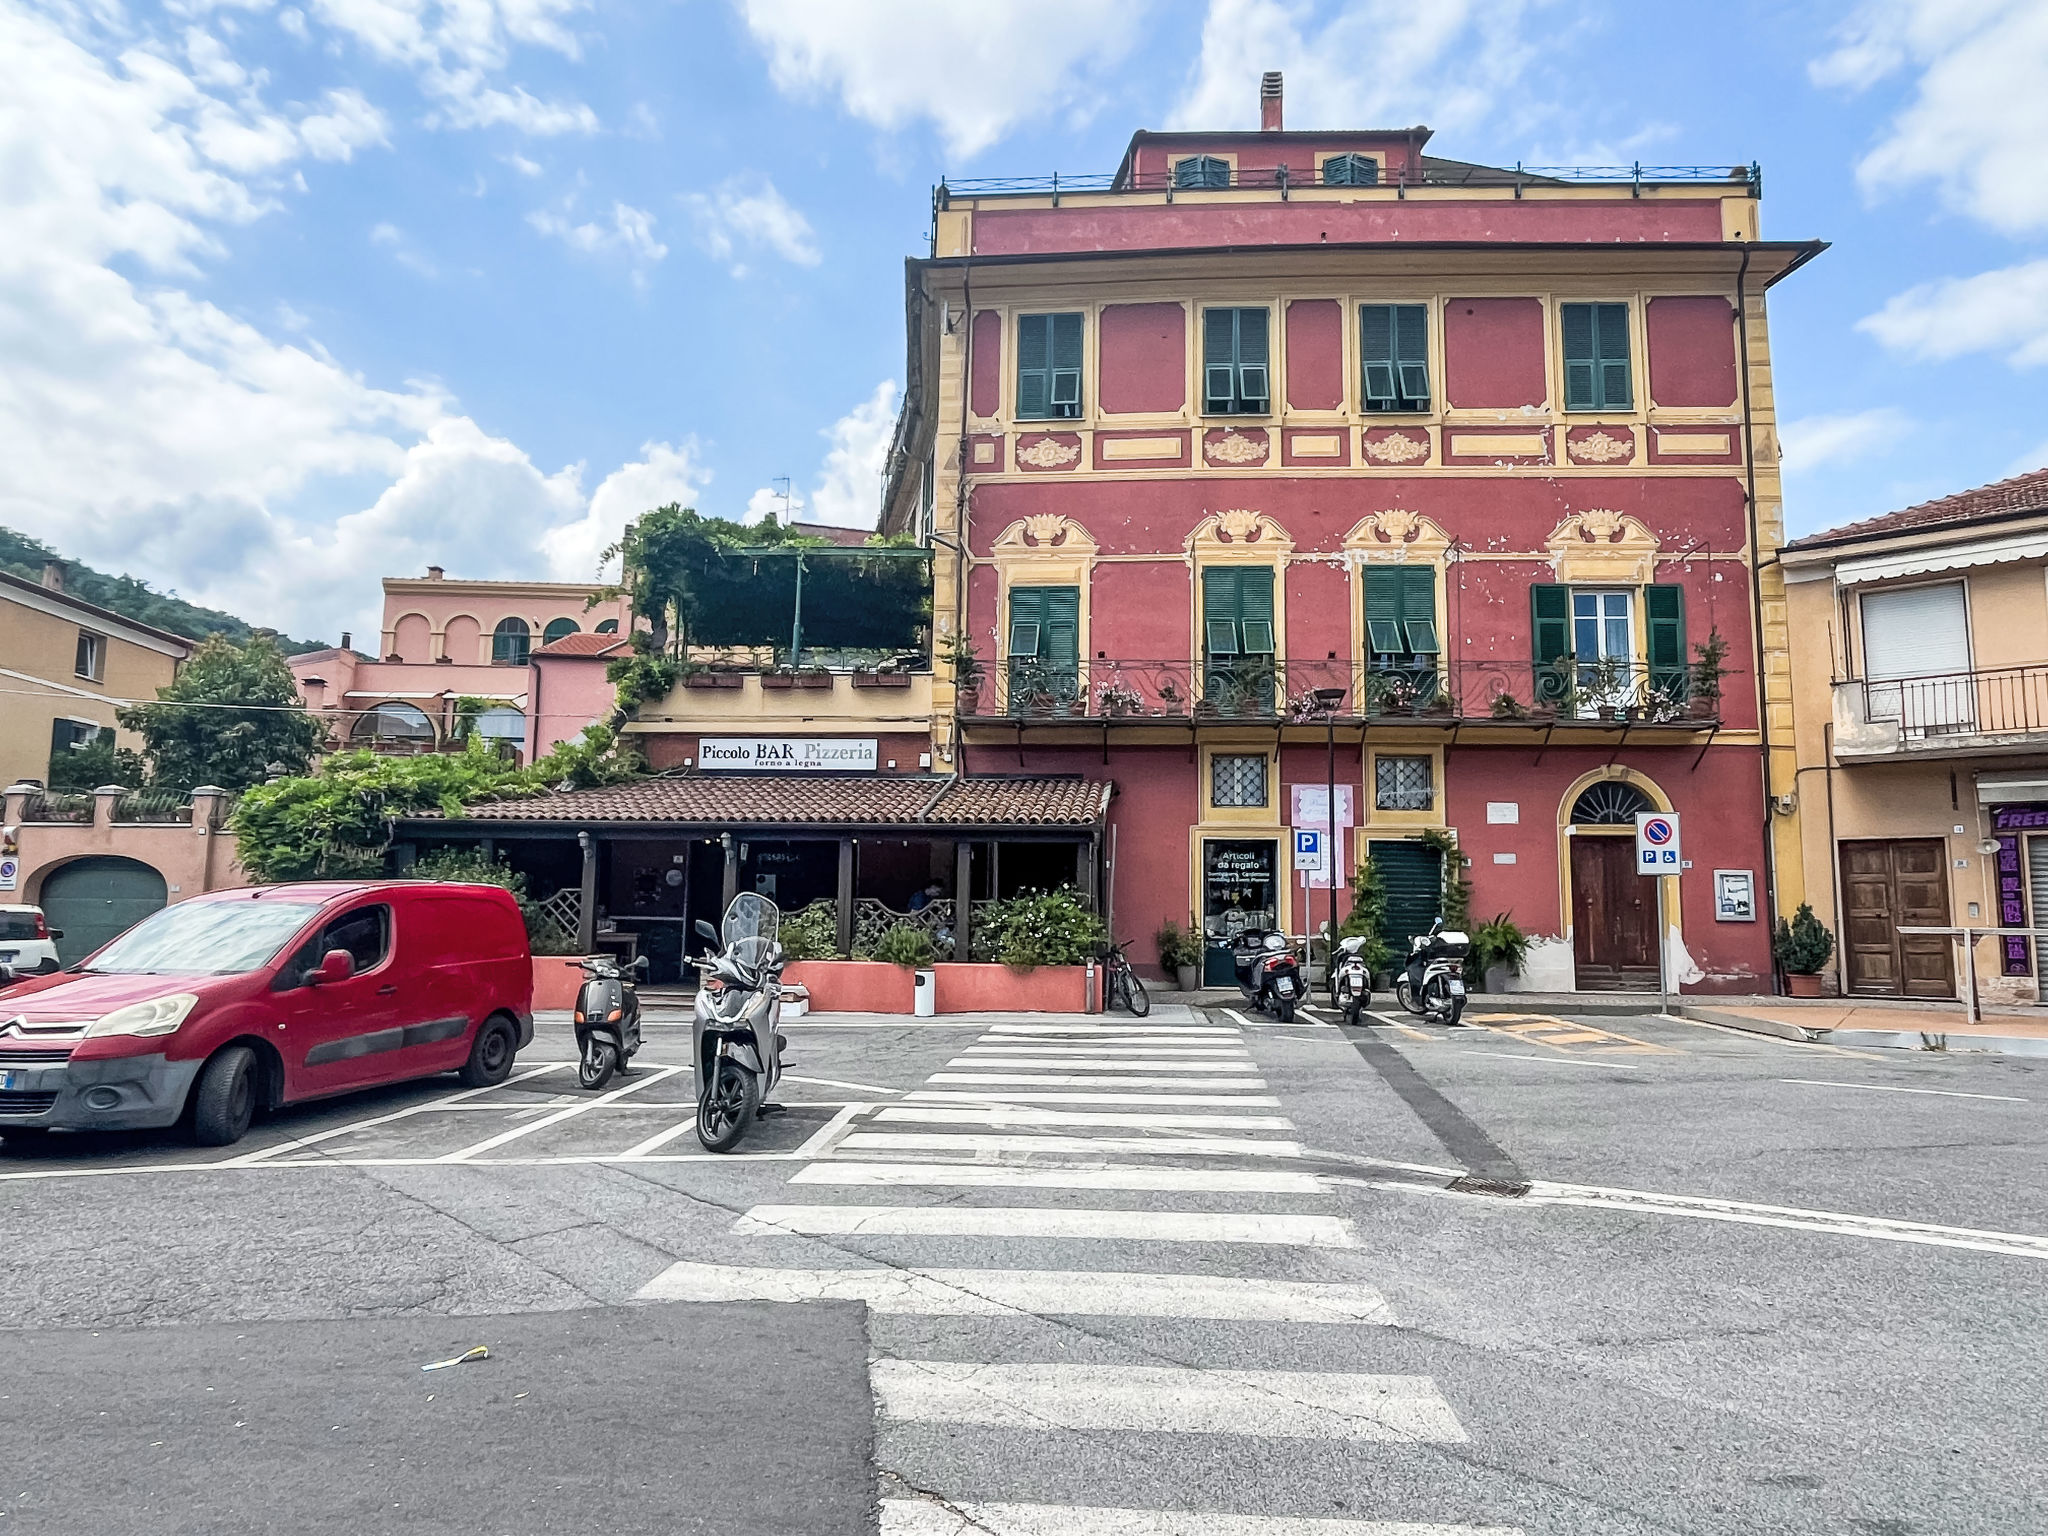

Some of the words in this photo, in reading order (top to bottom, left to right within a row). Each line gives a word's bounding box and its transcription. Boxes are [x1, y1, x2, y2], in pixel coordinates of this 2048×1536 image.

[702, 745, 750, 759] Piccolo
[755, 743, 794, 759] BAR
[804, 742, 873, 760] Pizzeria
[754, 758, 782, 766] forno
[794, 758, 822, 768] legna
[1997, 811, 2048, 829] FREE
[1301, 834, 1314, 851] P
[1222, 851, 1255, 860] Articoli
[1645, 852, 1654, 862] P
[1217, 861, 1229, 869] da
[1231, 861, 1260, 870] regalo
